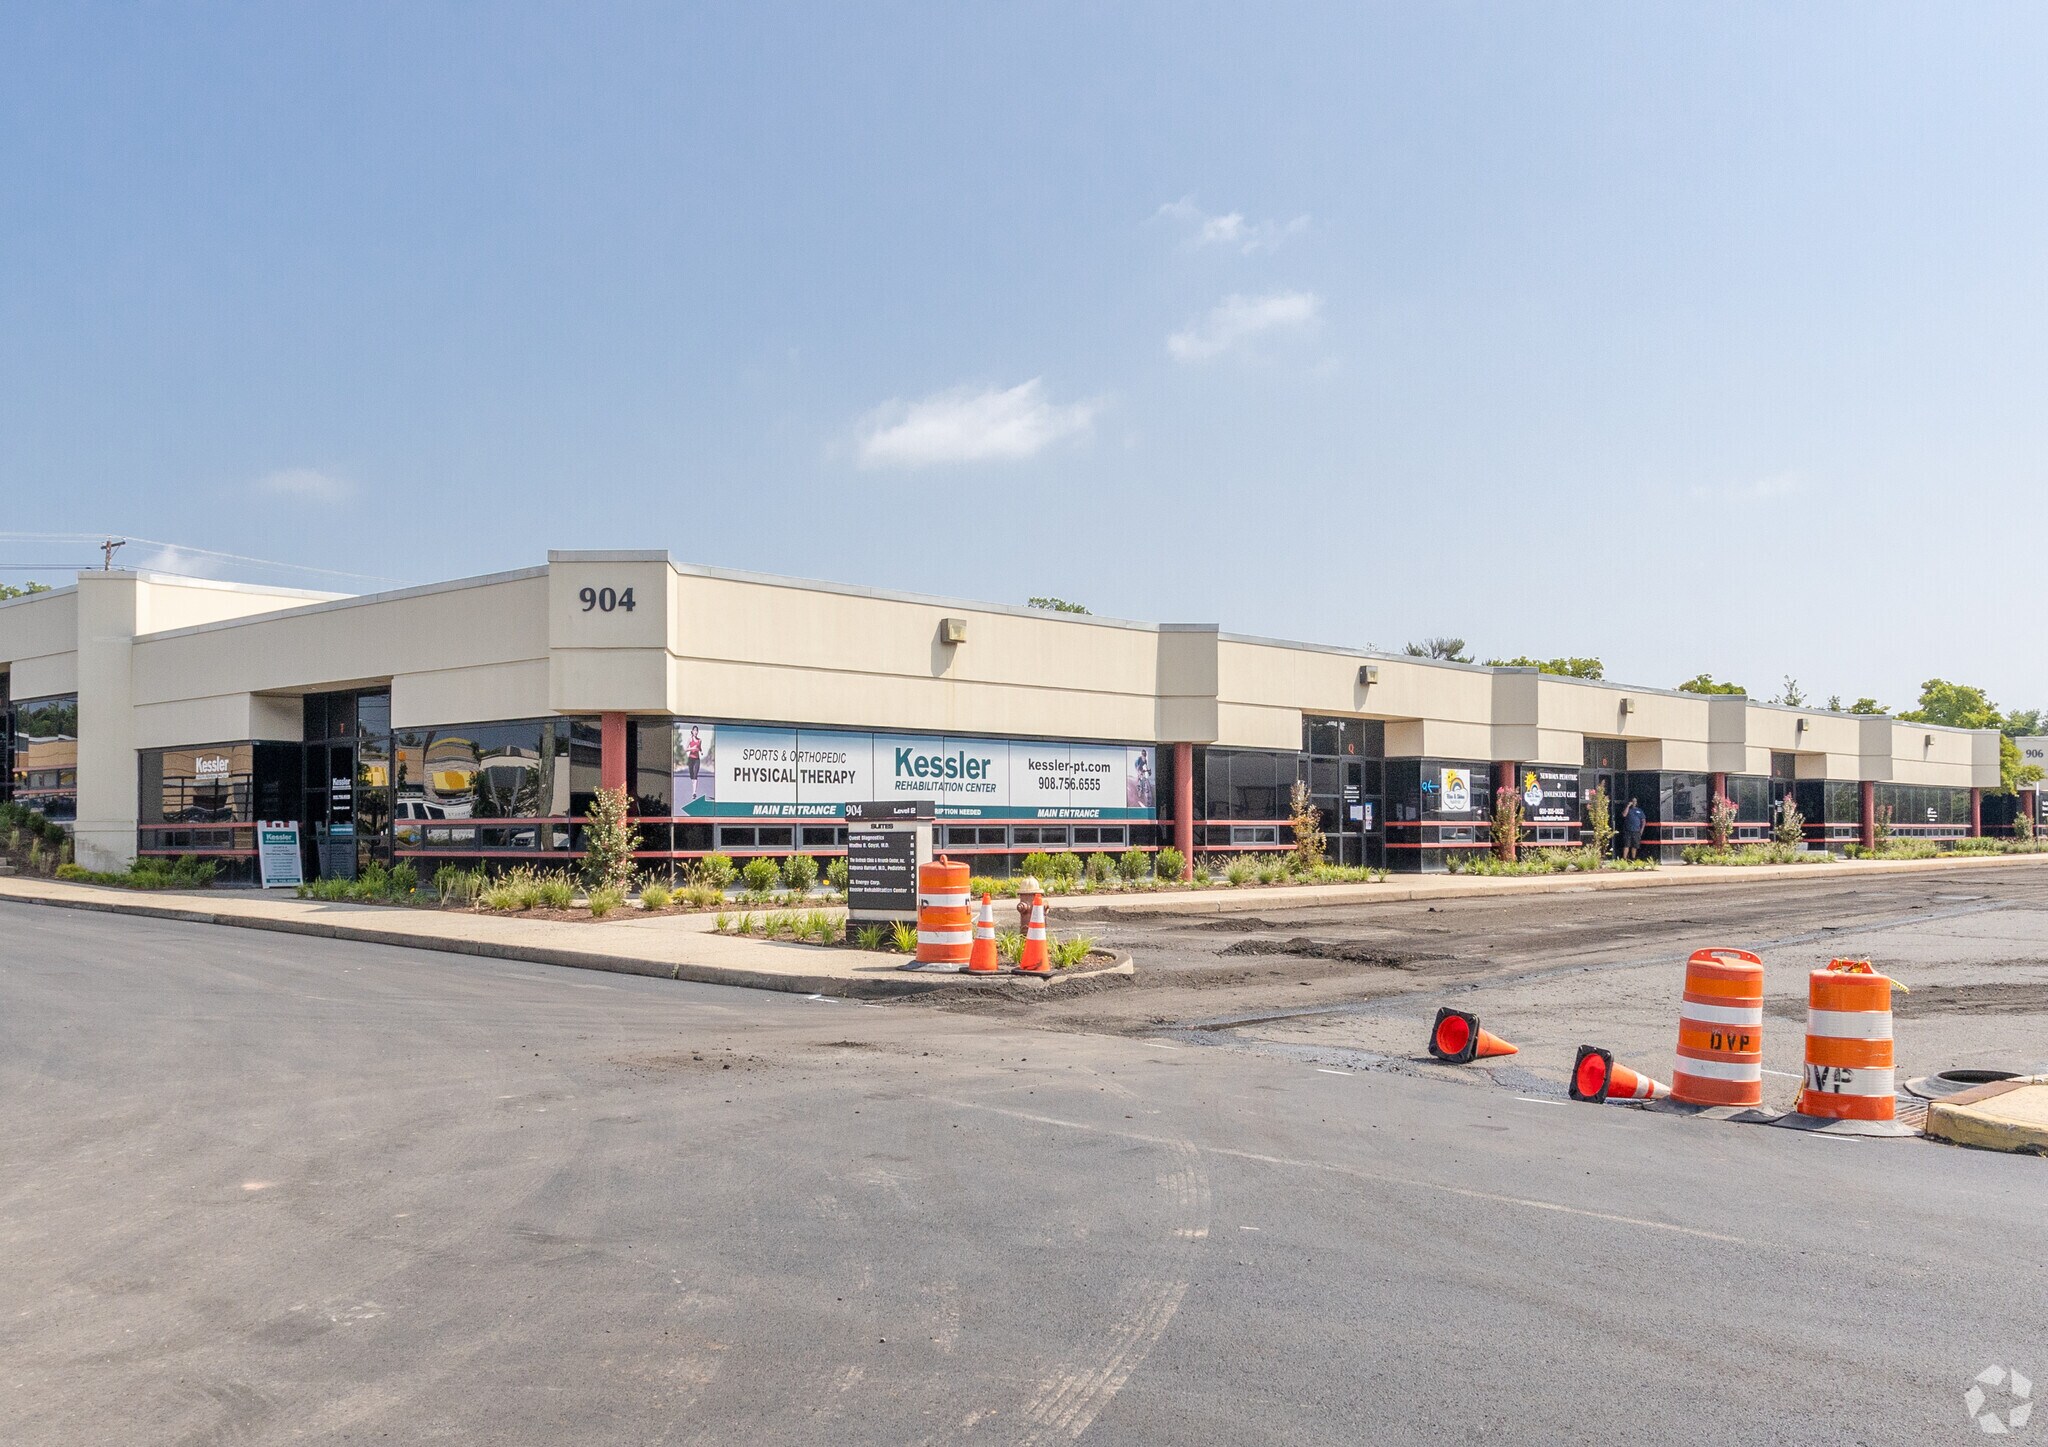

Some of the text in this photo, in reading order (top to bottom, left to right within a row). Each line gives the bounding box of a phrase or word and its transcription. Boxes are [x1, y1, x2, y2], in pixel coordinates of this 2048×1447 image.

[579, 587, 636, 612] 904
[742, 748, 847, 764] SPORTS & ORTHOPEDIC
[2026, 749, 2044, 758] 906
[195, 756, 229, 773] Kessler
[895, 747, 991, 780] Kessler
[1028, 758, 1111, 774] kessler-pt.com
[733, 767, 856, 784] PHYSICAL THERAPY
[895, 780, 997, 793] REHABILITATION CENTER
[1038, 776, 1101, 791] 908.756.6555
[752, 804, 837, 815] MAIN ENTRANCE
[845, 804, 863, 816] 904
[1037, 808, 1100, 818] MAIN ENTRANCE
[266, 833, 292, 841] Kessler
[1710, 1032, 1750, 1051] DVP
